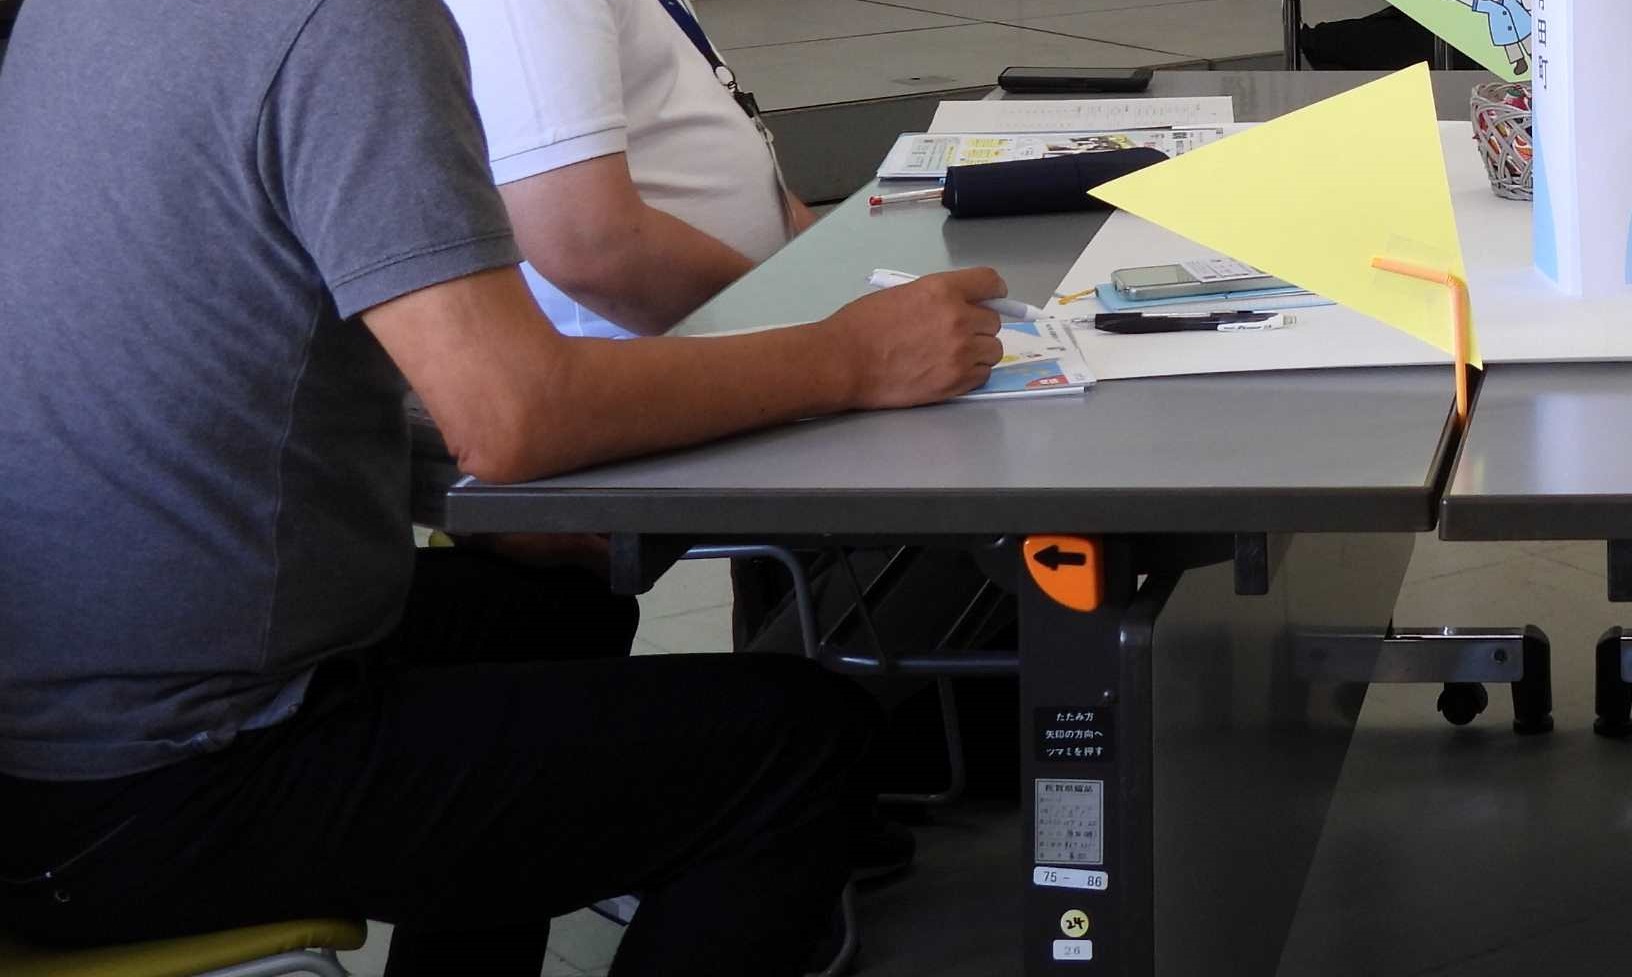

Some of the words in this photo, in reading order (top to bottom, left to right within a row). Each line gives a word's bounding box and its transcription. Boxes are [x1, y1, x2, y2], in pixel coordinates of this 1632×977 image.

[1056, 712, 1094, 722] たたみ方
[1045, 729, 1103, 740] 矢印の方向へ
[1046, 746, 1103, 757] ツマミを押す
[1043, 871, 1057, 883] 75
[1087, 875, 1102, 887] 86
[1065, 917, 1085, 930] 24
